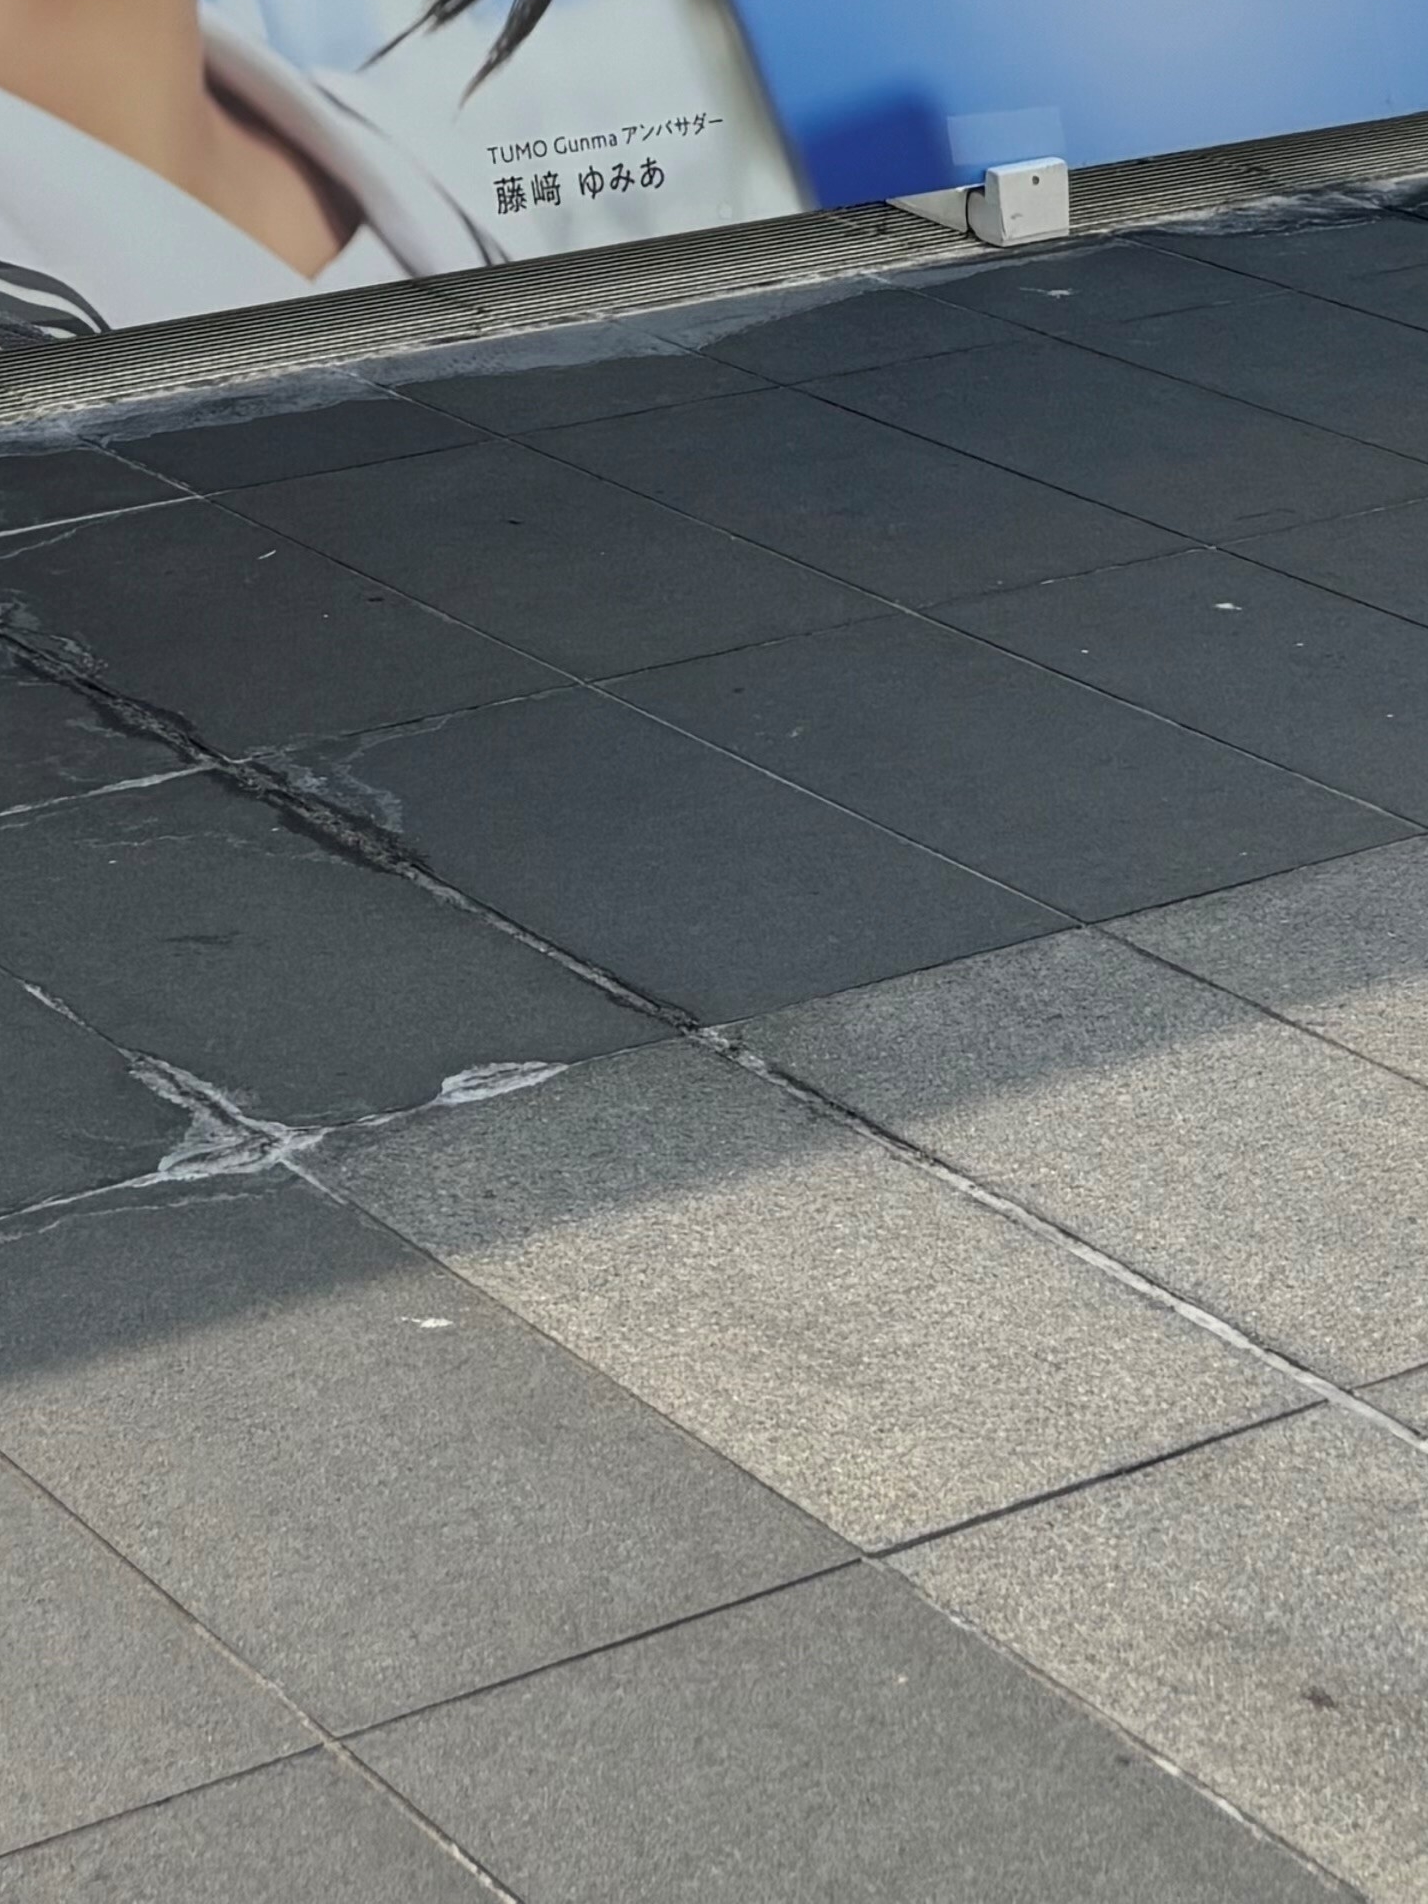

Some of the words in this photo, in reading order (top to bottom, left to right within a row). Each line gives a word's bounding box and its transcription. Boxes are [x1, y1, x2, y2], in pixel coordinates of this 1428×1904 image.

[487, 140, 548, 164] TUMO
[579, 157, 665, 199] ゆみあ
